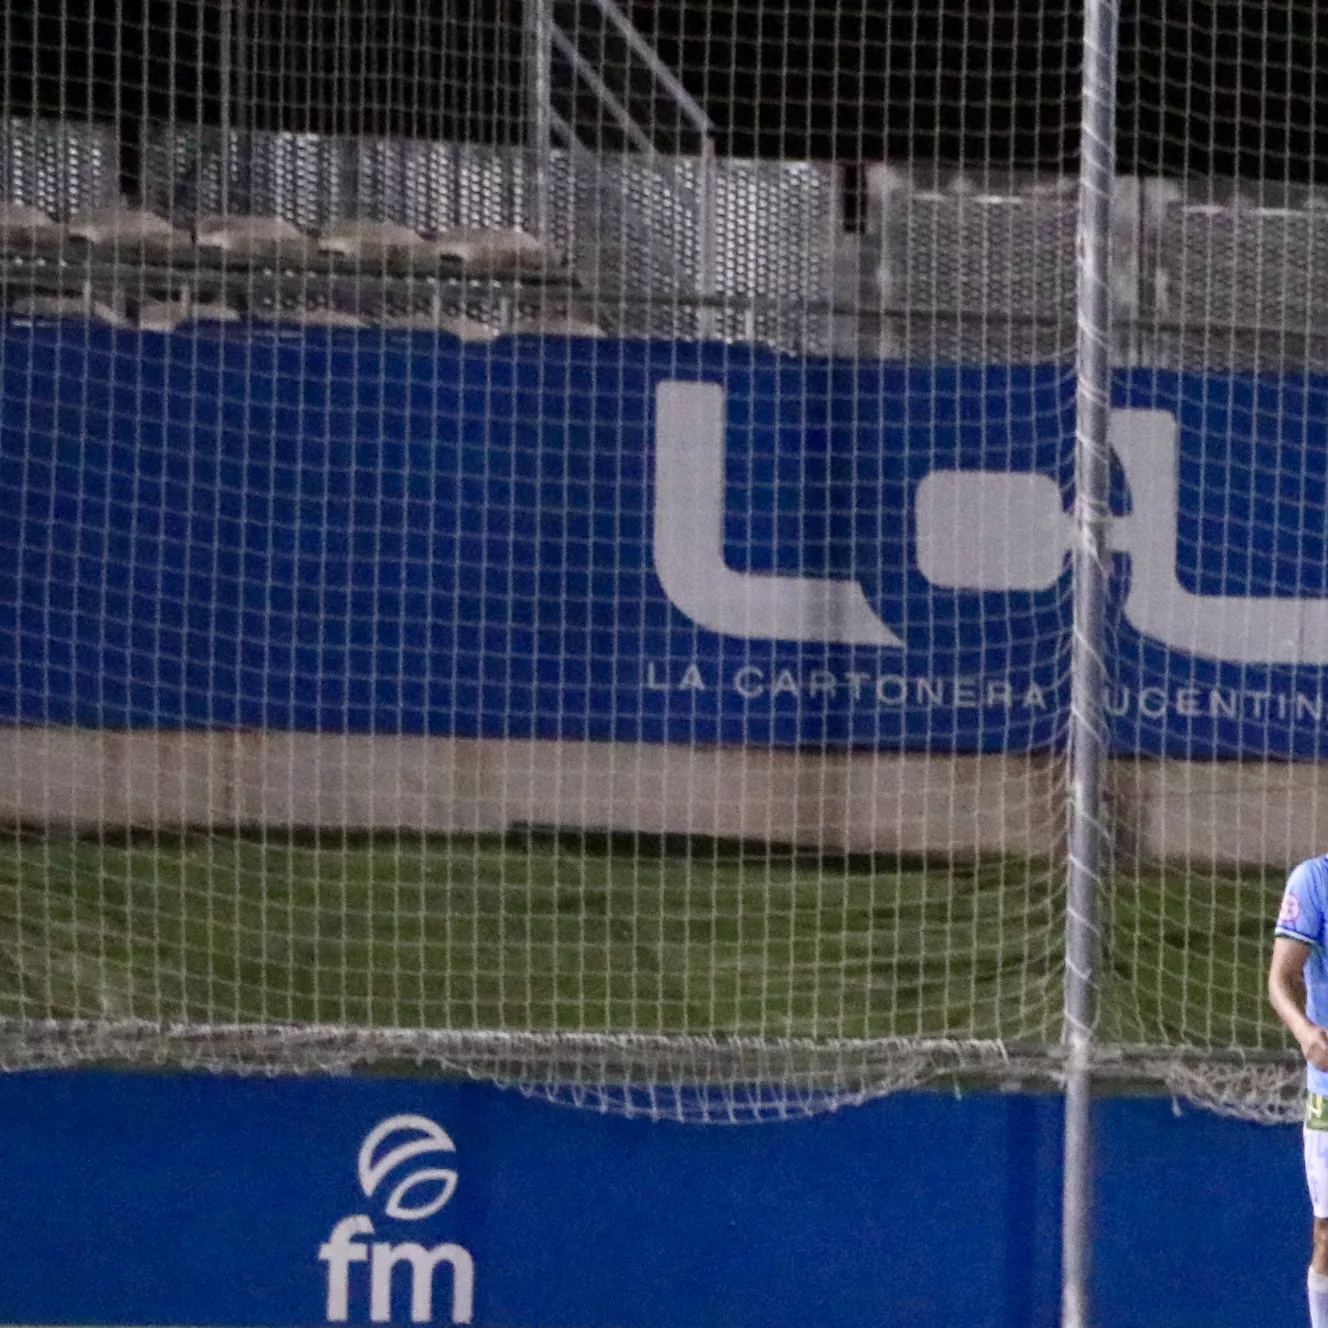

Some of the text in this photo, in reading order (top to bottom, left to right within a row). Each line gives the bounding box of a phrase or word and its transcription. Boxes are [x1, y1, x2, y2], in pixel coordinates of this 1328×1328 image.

[647, 661, 706, 692] LA
[732, 664, 1047, 711] CARTONERA
[318, 1214, 474, 1324] fm
